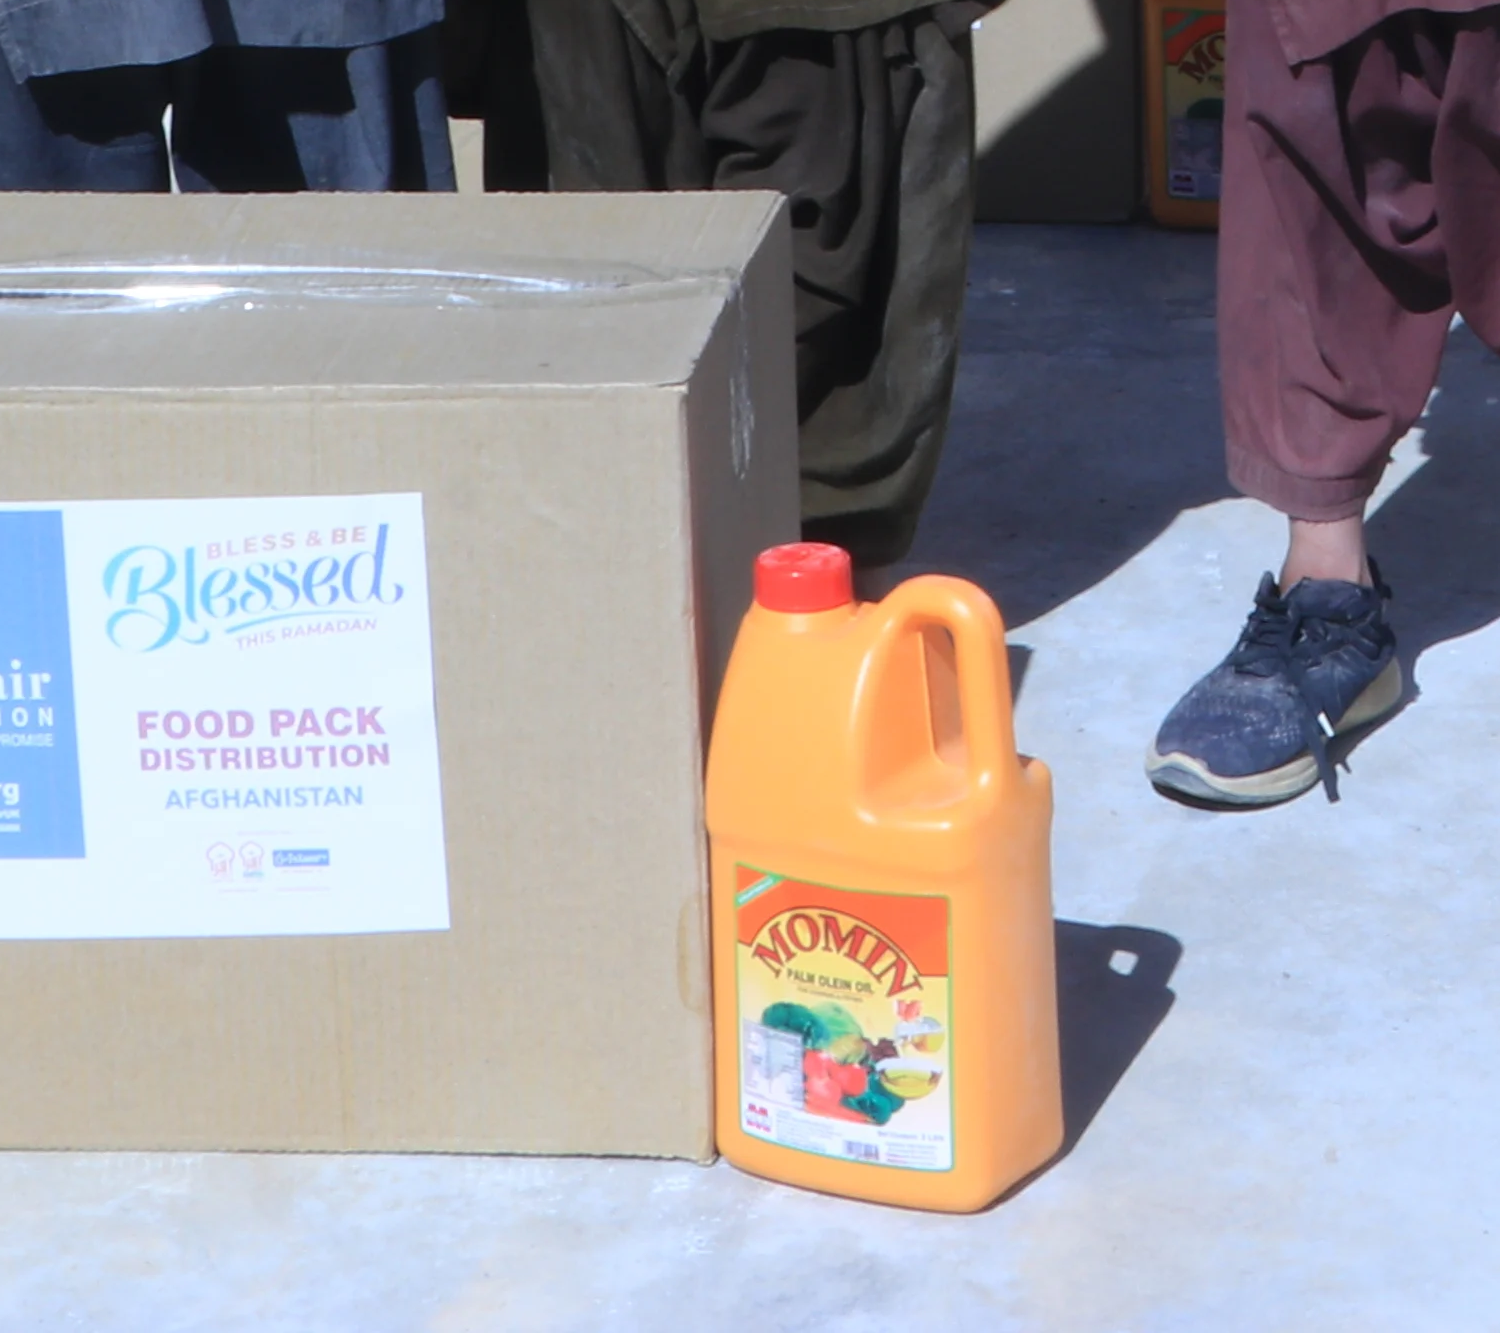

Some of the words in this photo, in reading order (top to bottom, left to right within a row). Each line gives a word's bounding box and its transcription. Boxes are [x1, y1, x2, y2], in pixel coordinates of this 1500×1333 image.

[206, 531, 295, 560] BLESS
[305, 529, 322, 547] &
[331, 525, 367, 545] BE
[102, 523, 404, 653] Blessed
[235, 631, 276, 651] THIS
[281, 618, 378, 641] RAMADAN
[137, 710, 254, 740] FOOD
[269, 706, 386, 737] PACK
[140, 743, 390, 772] DISTRIBUTION
[164, 785, 364, 810] AFGHANISTAN
[751, 913, 924, 998] MOMIN
[786, 968, 817, 985] PALM
[818, 974, 852, 991] OLEIN
[854, 980, 875, 995] OIL
